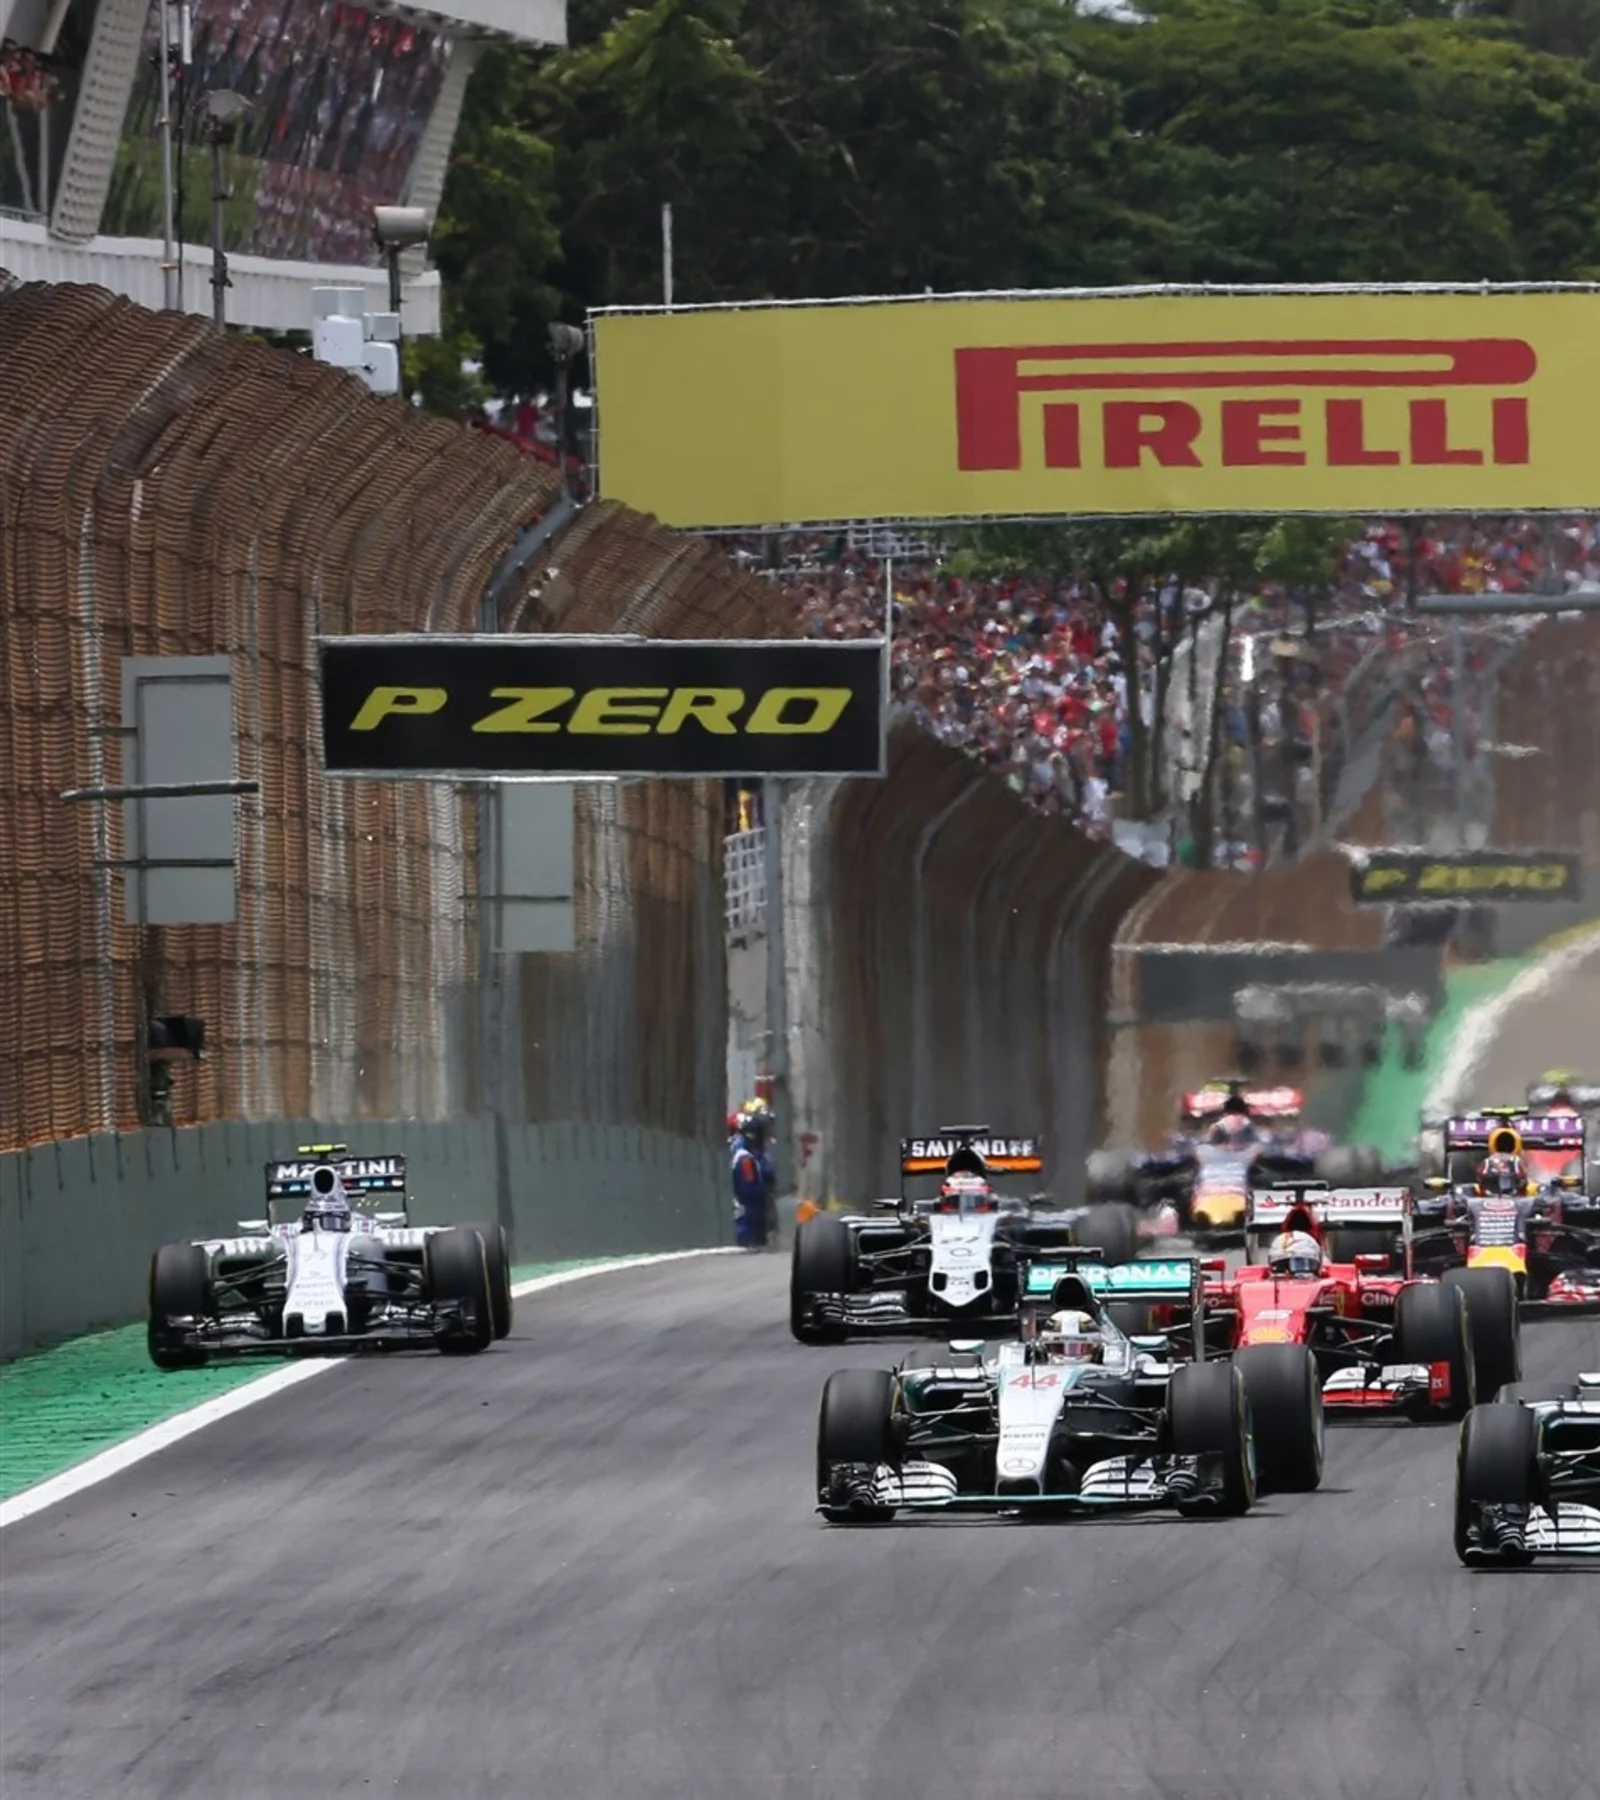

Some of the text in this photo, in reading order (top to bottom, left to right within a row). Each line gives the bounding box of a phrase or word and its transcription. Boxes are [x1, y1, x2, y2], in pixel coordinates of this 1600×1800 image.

[958, 341, 1534, 468] PIRELLI
[350, 686, 853, 736] P ZERO
[1449, 1118, 1584, 1132] INFNITI
[911, 1139, 1034, 1158] SMINOFF
[277, 1160, 396, 1179] MATINI
[1031, 1264, 1191, 1282] PERONAS
[1008, 1373, 1062, 1389] 44
